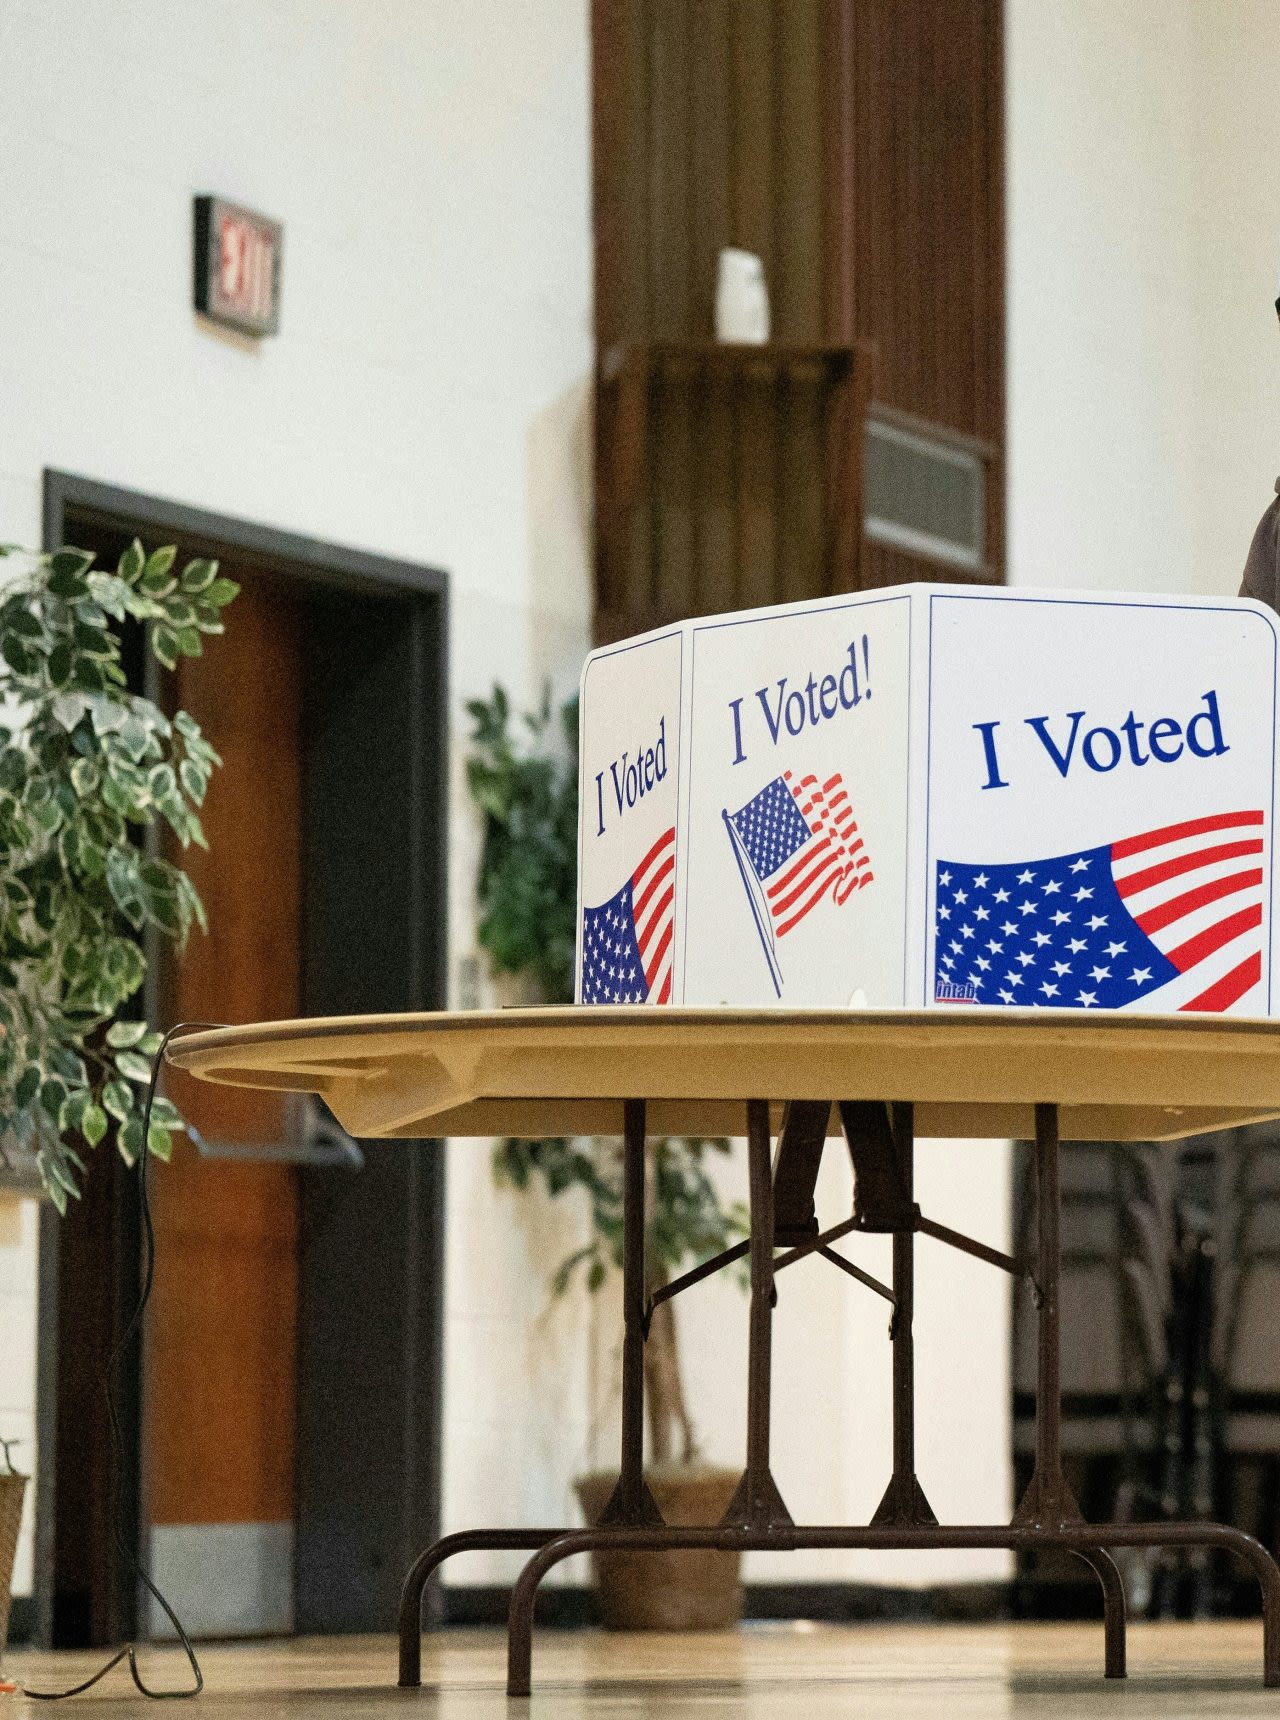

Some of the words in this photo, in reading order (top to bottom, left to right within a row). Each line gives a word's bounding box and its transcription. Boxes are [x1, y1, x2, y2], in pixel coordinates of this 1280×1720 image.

[728, 697, 748, 766] I
[754, 633, 873, 746] Voted!
[972, 721, 1010, 791] I
[1024, 689, 1232, 778] Voted
[594, 771, 607, 838] I
[609, 715, 668, 818] Voted
[936, 981, 976, 999] intab
